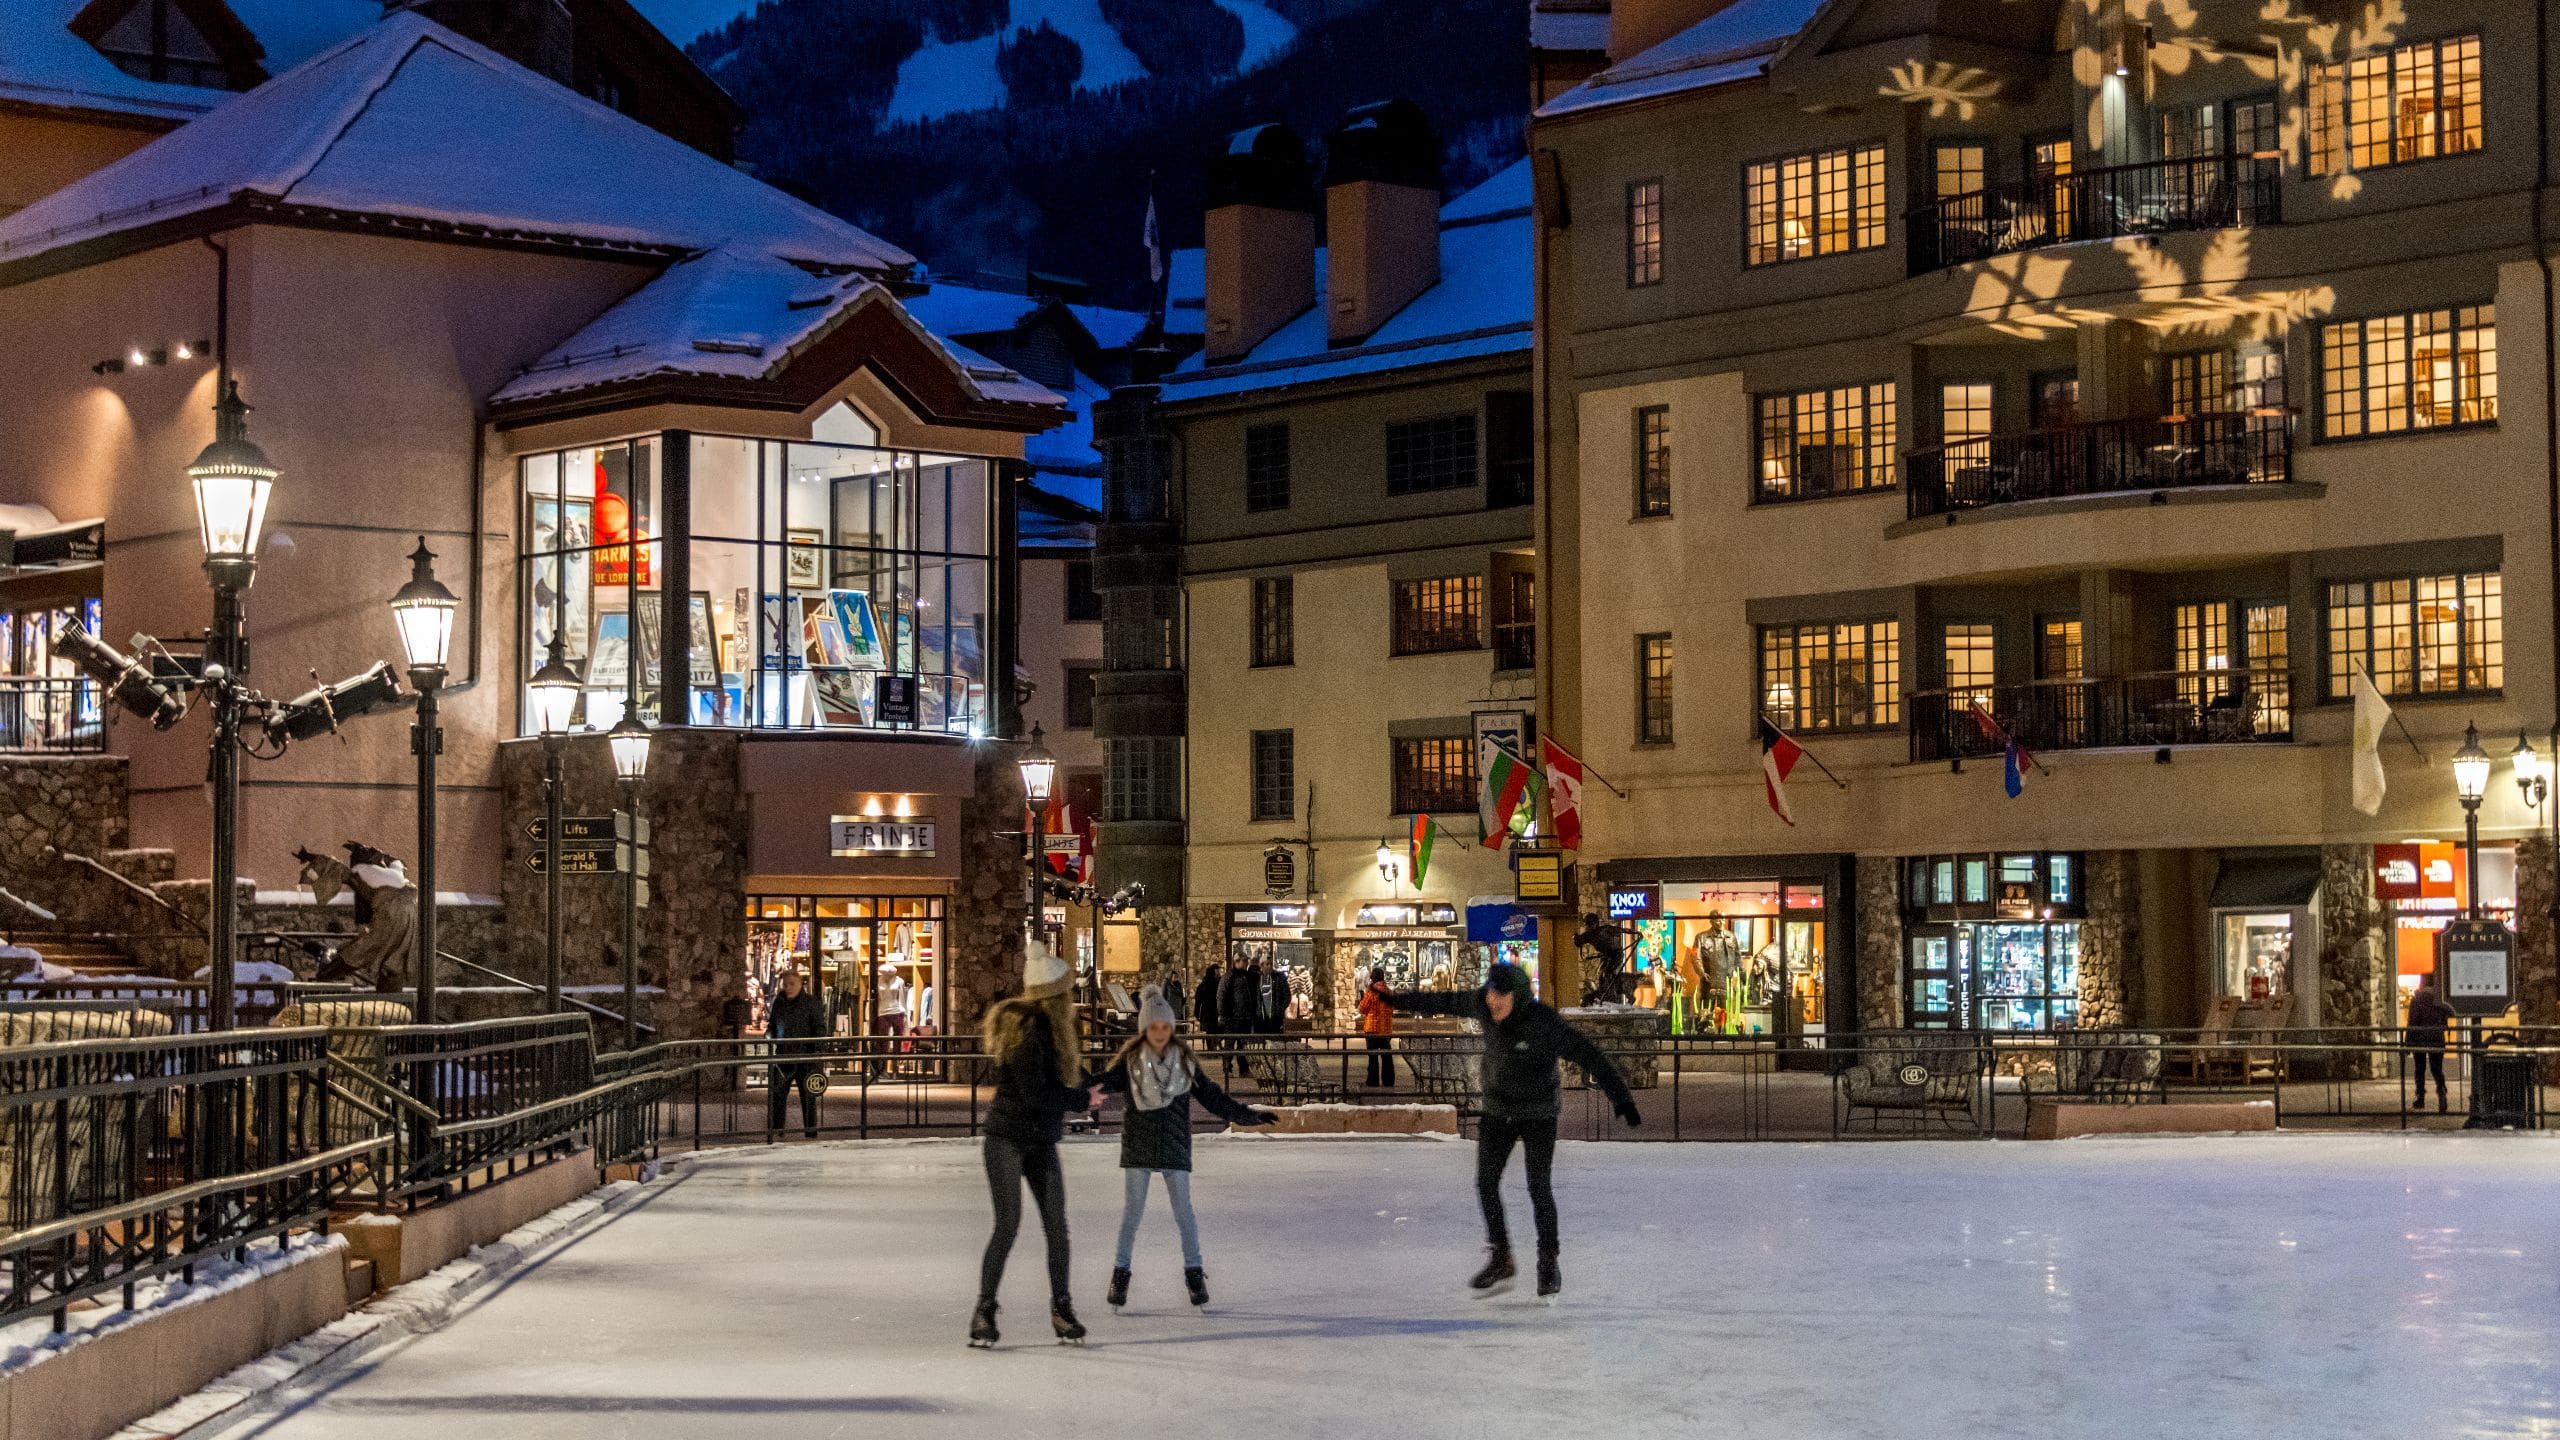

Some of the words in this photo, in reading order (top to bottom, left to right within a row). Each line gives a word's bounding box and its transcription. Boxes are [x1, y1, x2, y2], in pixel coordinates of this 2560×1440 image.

[883, 702, 910, 713] Vintage
[884, 712, 909, 720] Posters
[565, 824, 588, 834] Lifts
[843, 825, 928, 847] FRINJE
[560, 861, 577, 871] ord
[580, 861, 598, 871] Hall
[1610, 893, 1646, 907] KNOX
[2452, 934, 2502, 942] EVENTS
[1960, 973, 1969, 1029] PIECES
